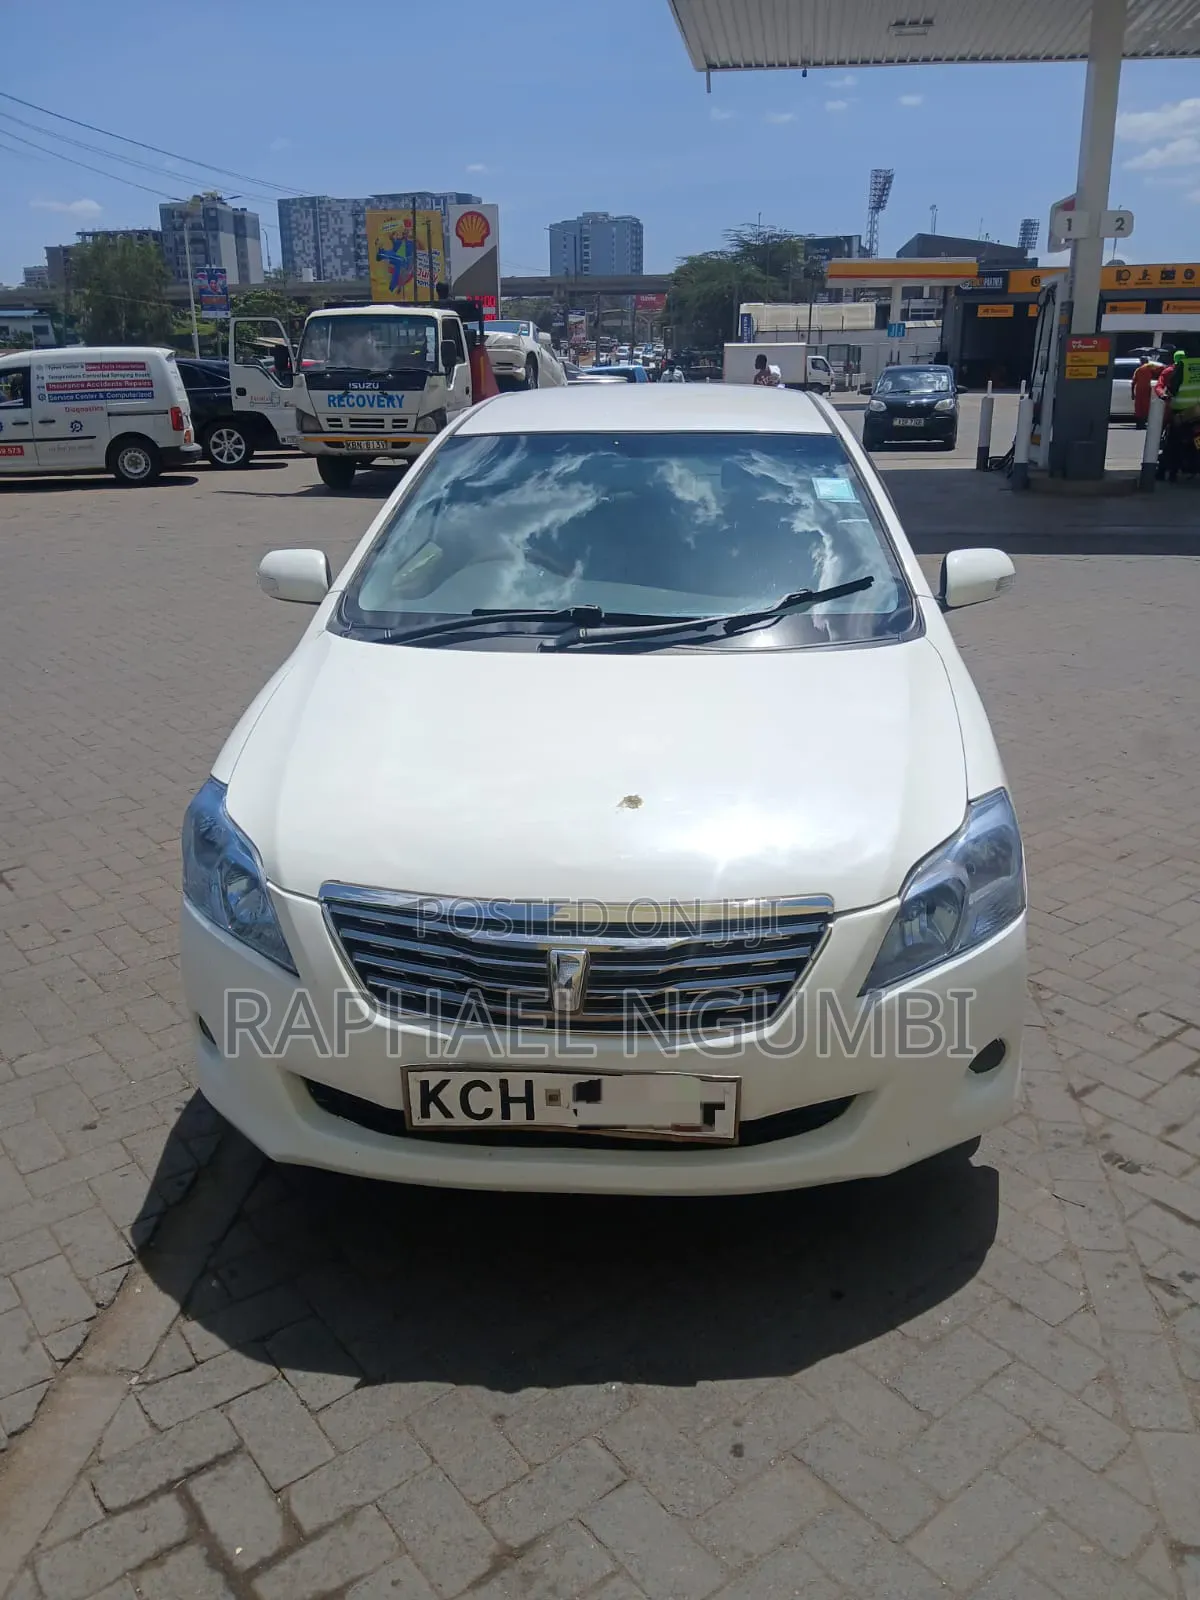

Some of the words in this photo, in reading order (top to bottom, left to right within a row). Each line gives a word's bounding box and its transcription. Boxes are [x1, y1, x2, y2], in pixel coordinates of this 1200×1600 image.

[1066, 218, 1073, 232] 1
[1115, 217, 1125, 231] 2
[106, 391, 152, 399] Computerized
[327, 393, 405, 409] RECOVERY
[64, 405, 104, 413] Diagnostics
[419, 1078, 536, 1121] KCH
